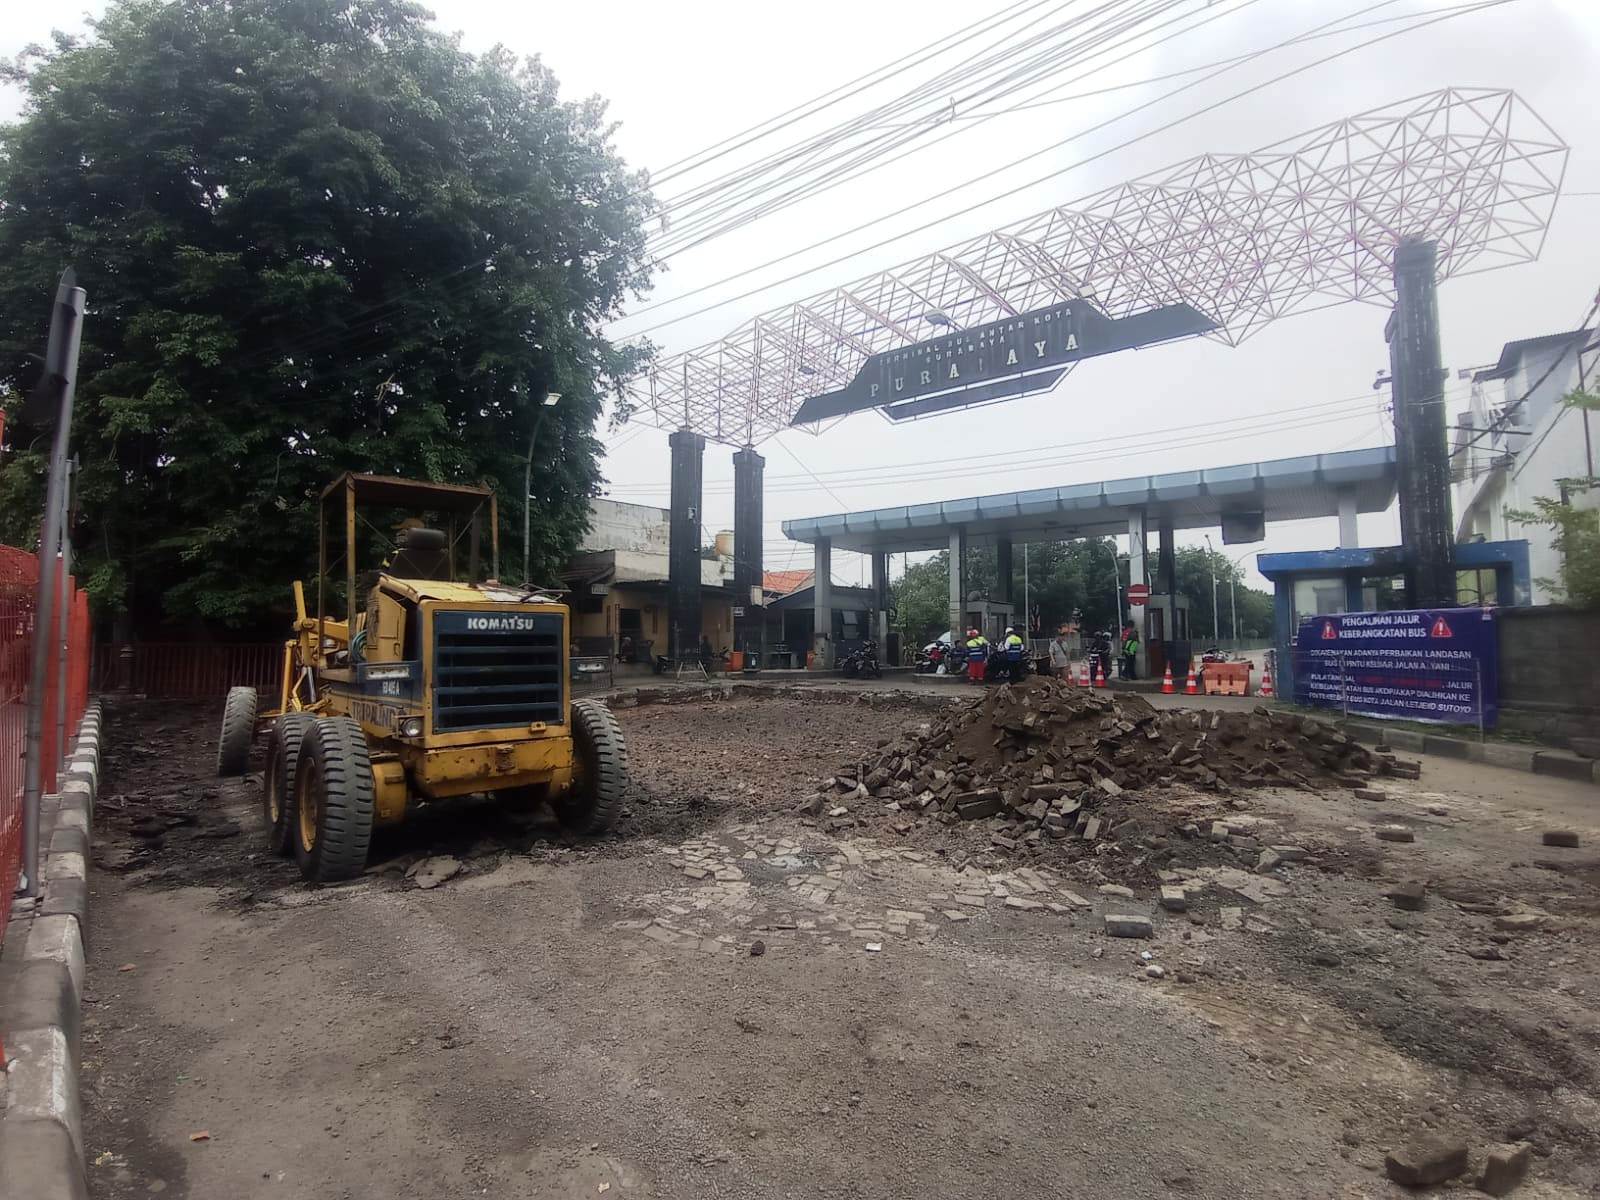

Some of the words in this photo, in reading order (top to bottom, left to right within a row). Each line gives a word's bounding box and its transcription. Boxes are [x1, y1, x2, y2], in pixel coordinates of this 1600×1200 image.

[980, 320, 1024, 338] ANTAR
[1034, 308, 1072, 325] KOTA
[871, 333, 1079, 397] PURAAYA
[467, 616, 534, 630] KOMATSU
[1342, 616, 1393, 626] PENGALIHAN
[1394, 615, 1420, 625] JALUR
[1339, 628, 1407, 638] KEBERANGKATAN
[1408, 628, 1427, 637] BUS
[1380, 649, 1422, 657] PERBAIKAN
[1425, 650, 1472, 658] LANDASAN
[1395, 661, 1419, 669] JALAN
[1430, 662, 1450, 671] YANI
[1446, 681, 1473, 689] JALUR
[1310, 682, 1362, 692] KEBERANGATAN
[1459, 694, 1471, 702] KE
[1380, 699, 1404, 707] JALAN
[1437, 704, 1472, 713] SUTOYO
